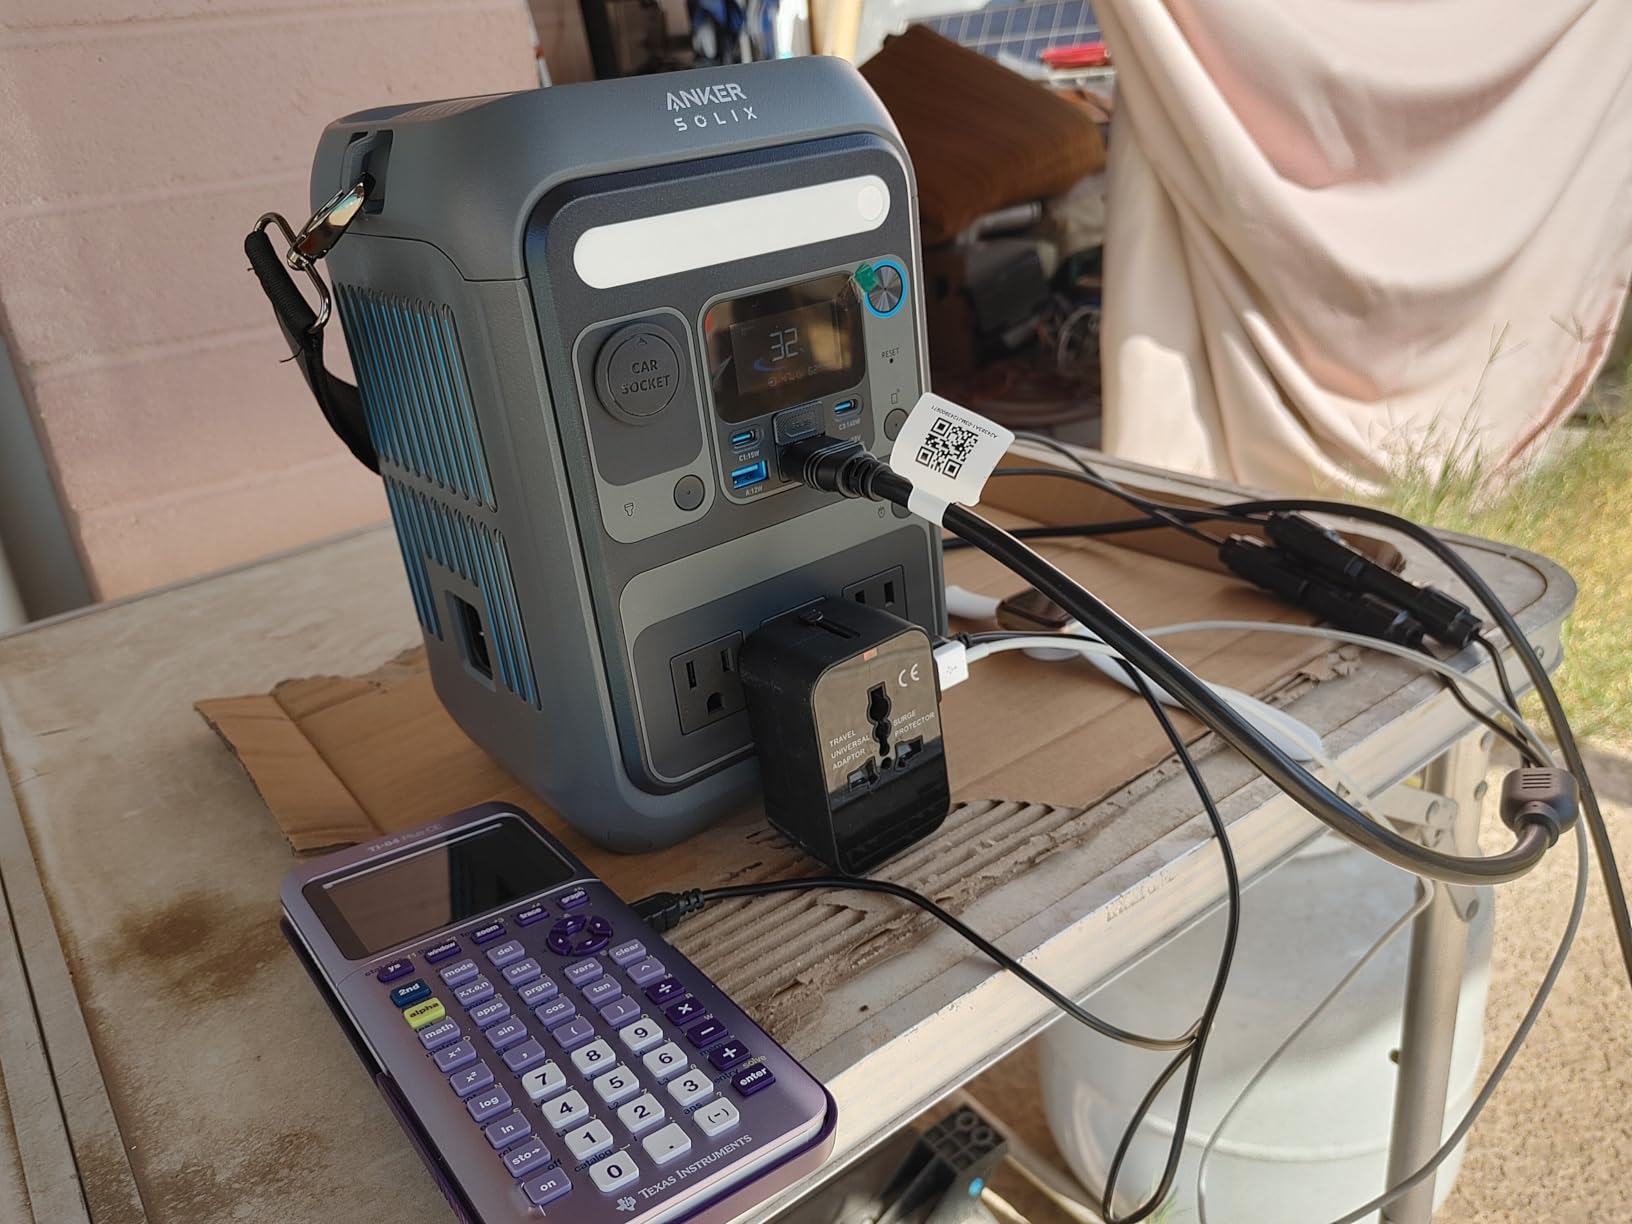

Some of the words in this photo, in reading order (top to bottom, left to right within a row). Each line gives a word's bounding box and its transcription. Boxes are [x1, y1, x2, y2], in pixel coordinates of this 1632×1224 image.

[667, 84, 747, 112] ANKER
[674, 106, 757, 131] SOLIX
[769, 328, 799, 361] 32
[881, 347, 900, 358] RESET
[632, 360, 658, 373] CAR
[622, 375, 670, 394] SOCKET
[738, 450, 760, 462] C1:15W
[745, 485, 763, 496] A:12W
[898, 663, 920, 687] CE
[893, 709, 916, 726] SURGE
[894, 711, 935, 737] PROTECTOR
[829, 729, 856, 747] TRAVEL
[831, 735, 870, 759] UNIVERSAL
[832, 748, 866, 770] ADAPTOR
[561, 890, 585, 904] graph
[518, 906, 543, 920] trace
[475, 924, 499, 937] zoom
[428, 942, 456, 956] window
[497, 945, 514, 956] del
[615, 944, 639, 956] clear
[444, 962, 474, 978] mode
[511, 963, 532, 975] stat
[573, 962, 595, 975] vars
[398, 983, 420, 996] 2nd
[524, 981, 551, 996] prgm
[592, 983, 611, 993] tan
[409, 1002, 439, 1018] alpha
[476, 1001, 503, 1017] apps
[545, 1003, 565, 1014] cos
[425, 1023, 454, 1039] math
[497, 1025, 515, 1036] sin
[634, 1027, 648, 1038] 9
[586, 1050, 600, 1061] 8
[659, 1053, 672, 1064] 6
[742, 1054, 767, 1069] solve
[534, 1072, 548, 1085] 7
[609, 1075, 624, 1089] 5
[714, 1068, 740, 1083] entry
[739, 1067, 768, 1086] enter
[683, 1080, 699, 1092] 3
[479, 1096, 499, 1109] log
[560, 1101, 573, 1114] 4
[683, 1102, 703, 1115] ans
[633, 1105, 651, 1119] 2
[707, 1108, 730, 1124] (-)
[501, 1124, 515, 1134] ln
[582, 1131, 597, 1144] 1
[547, 1158, 562, 1171] off
[574, 1149, 613, 1172] catalog
[637, 1175, 677, 1199] TEXAS
[676, 1134, 753, 1180] INSTRUMENTS
[606, 1164, 623, 1179] 0
[540, 1180, 557, 1192] on
